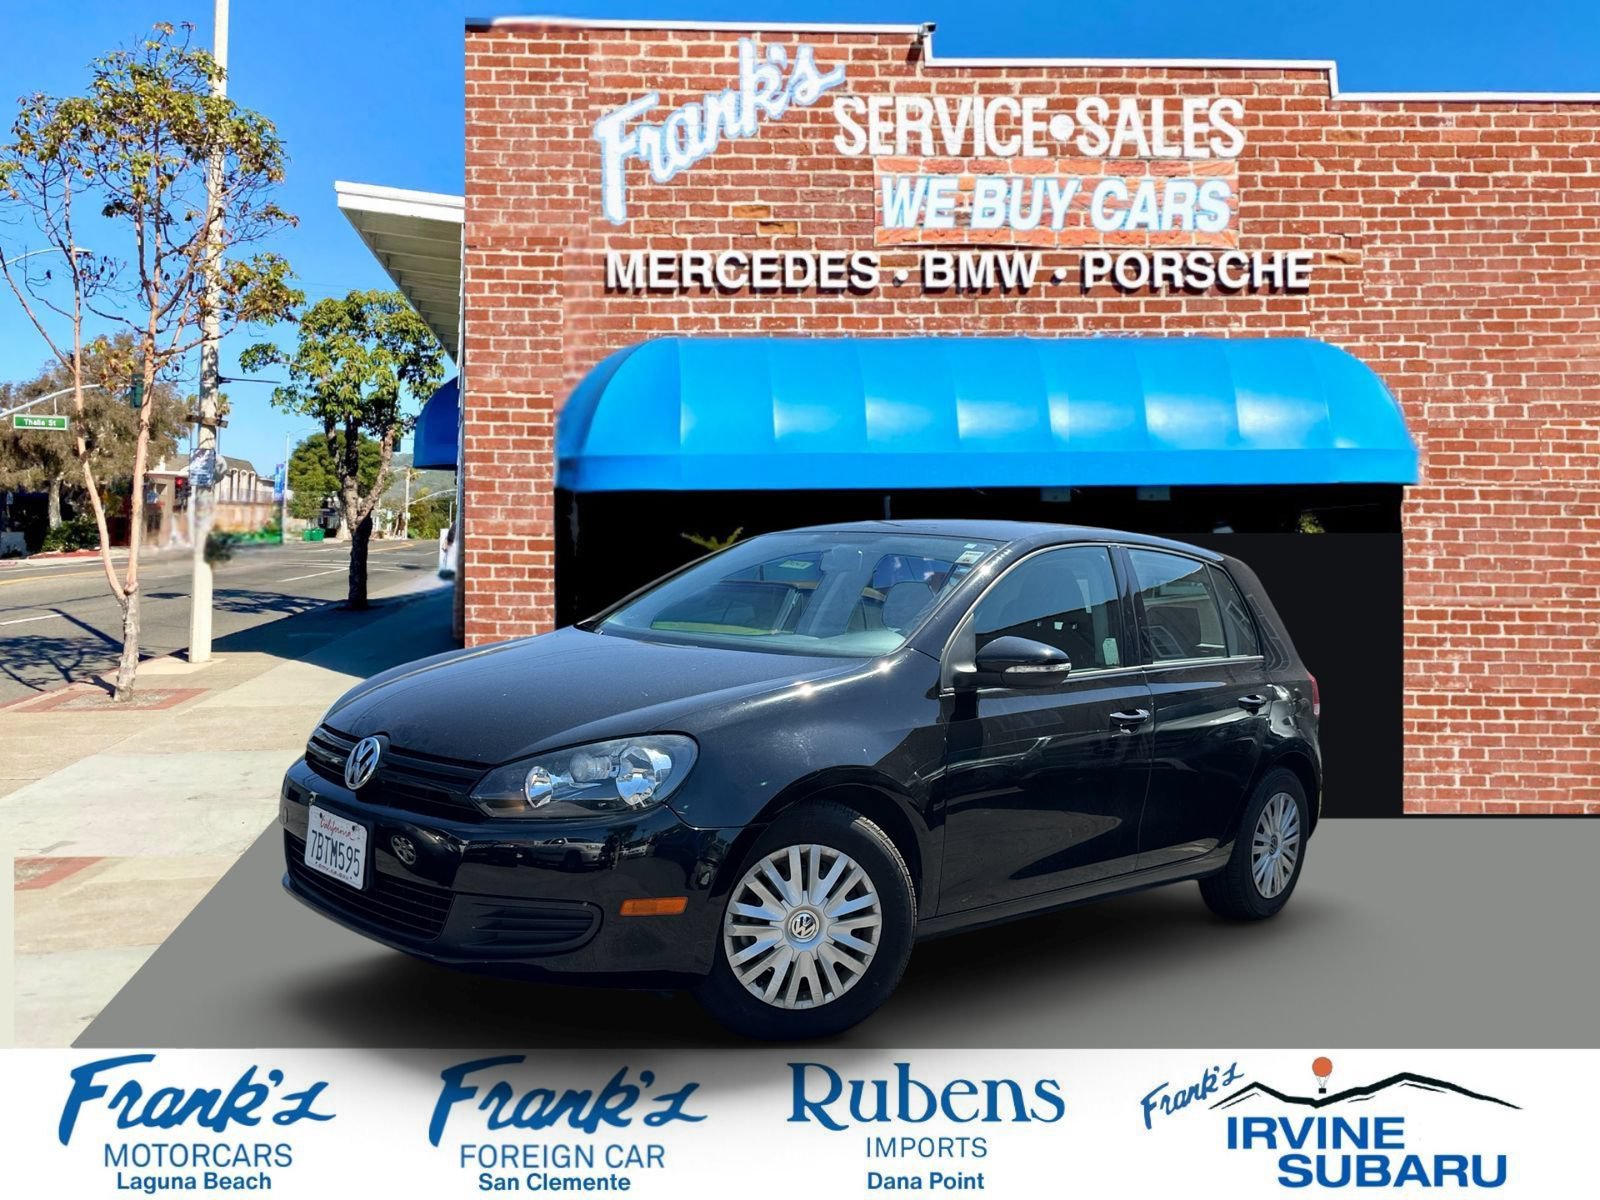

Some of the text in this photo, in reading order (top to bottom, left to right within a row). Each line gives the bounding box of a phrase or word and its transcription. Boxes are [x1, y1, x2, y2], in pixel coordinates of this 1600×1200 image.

[593, 37, 846, 226] Frank's
[880, 175, 1233, 233] WE BUY CARS
[605, 250, 1314, 292] MERCEDES BMW PORSCHE
[48, 419, 57, 427] St
[310, 829, 361, 877] 7BTM595
